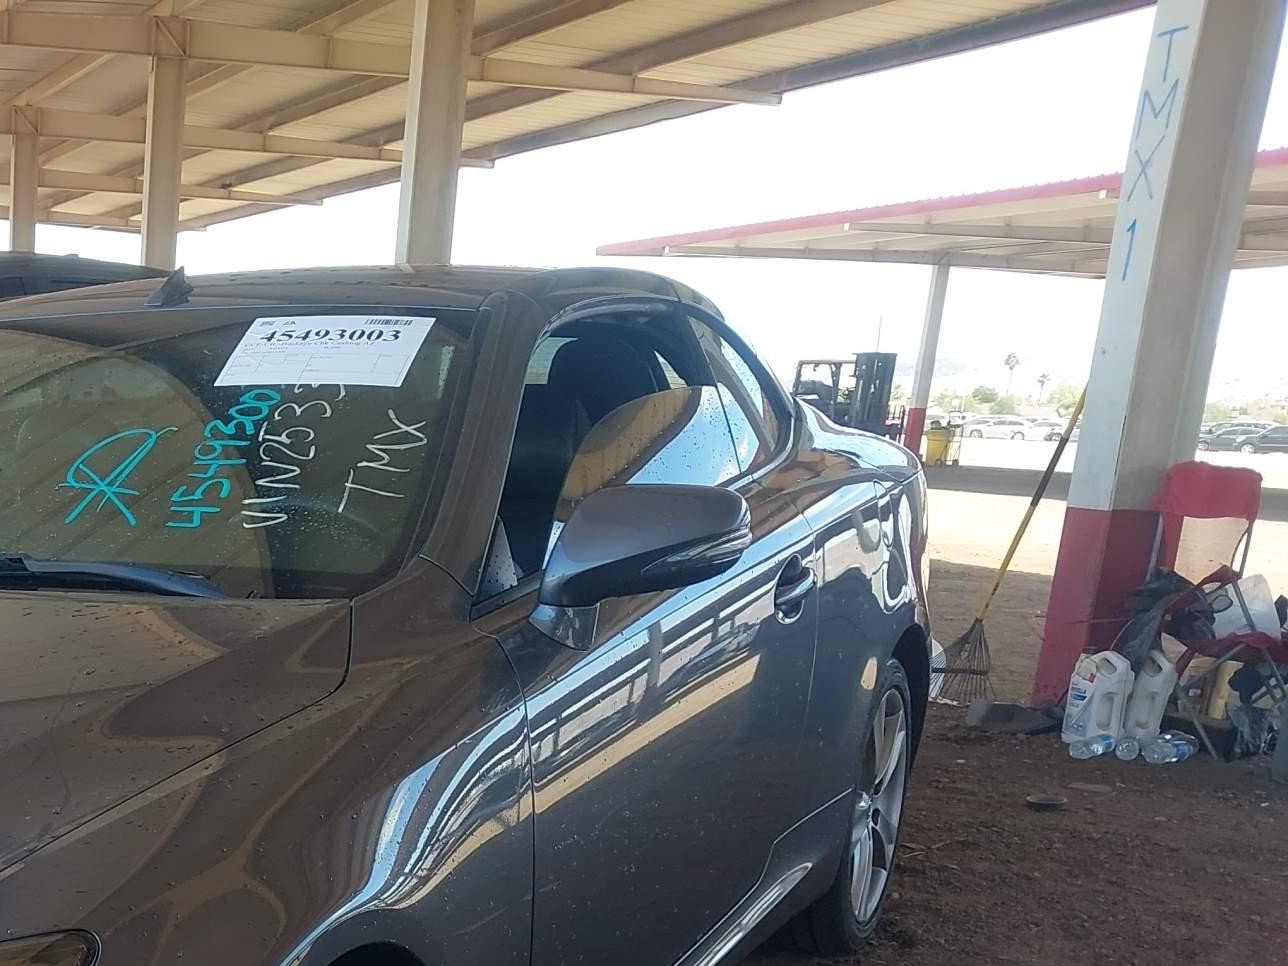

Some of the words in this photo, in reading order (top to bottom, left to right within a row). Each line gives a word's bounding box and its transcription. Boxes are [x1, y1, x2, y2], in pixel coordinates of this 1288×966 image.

[260, 329, 402, 343] 45493003
[165, 385, 281, 528] 4549300
[338, 408, 428, 514] TMX
